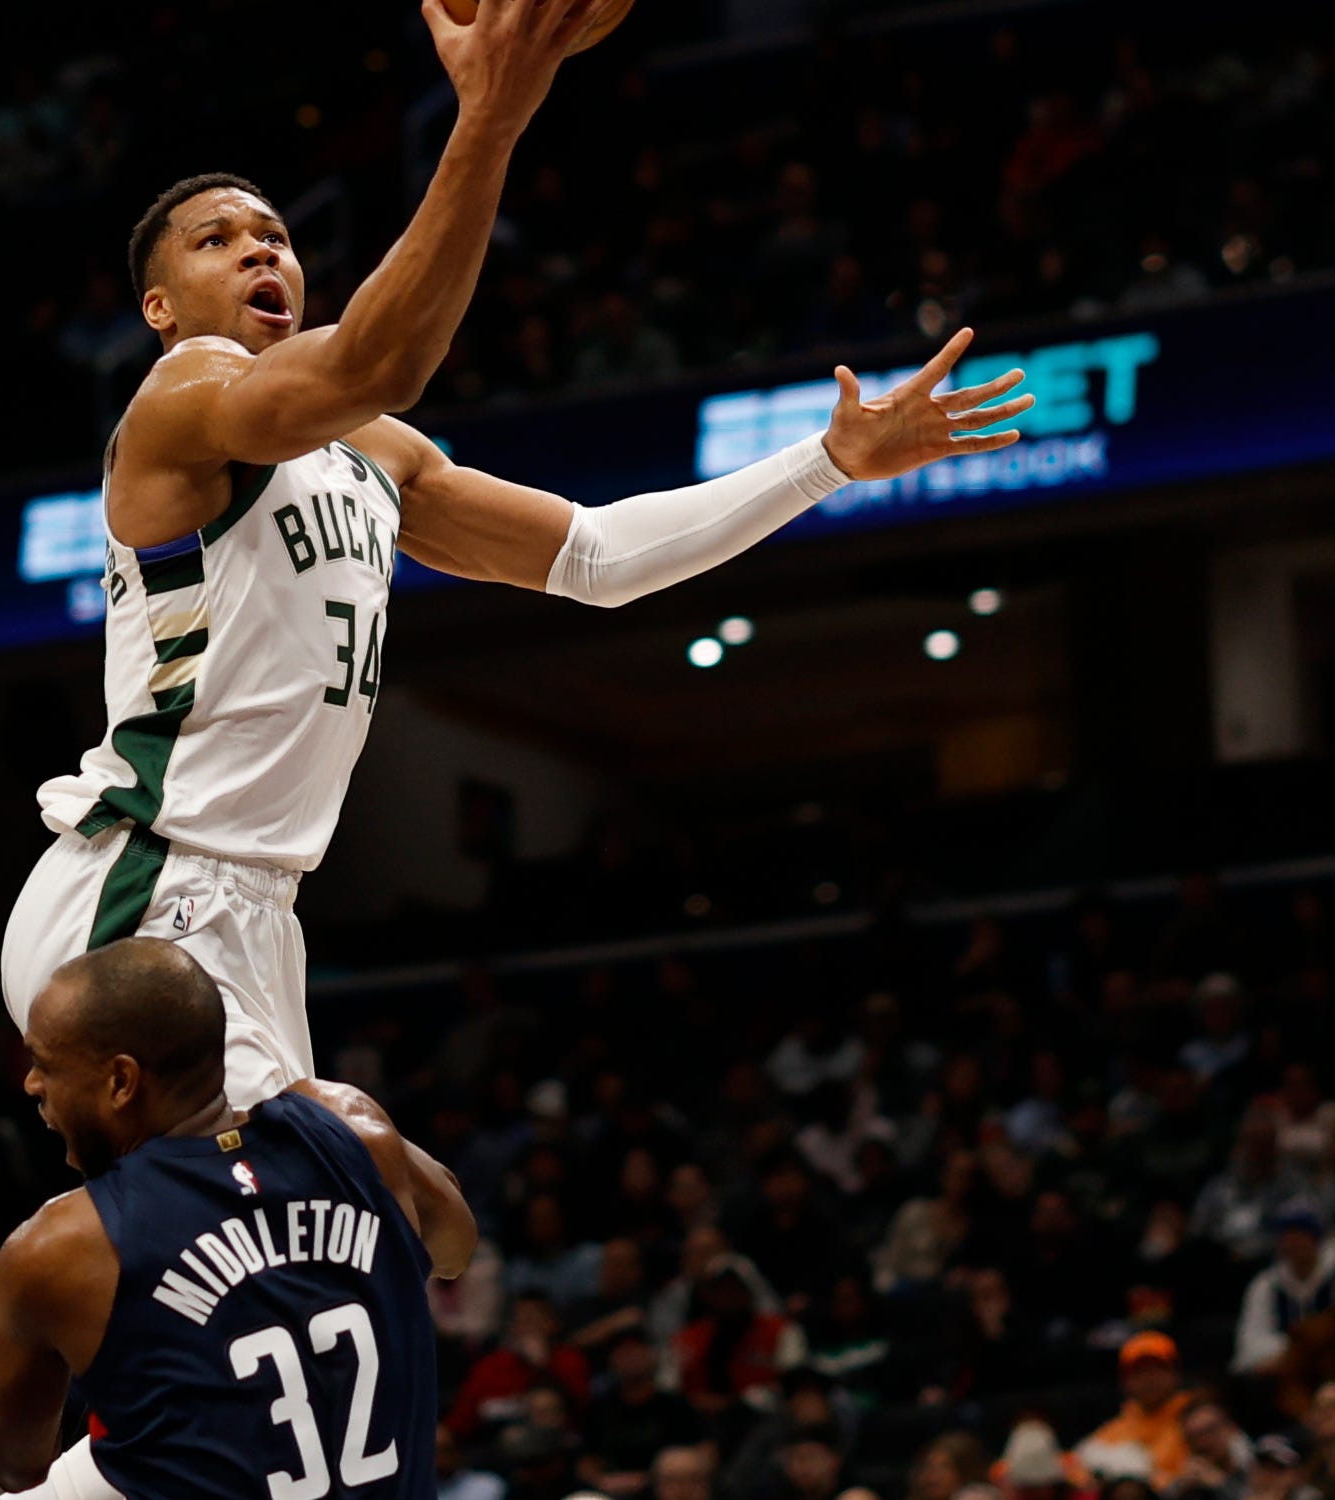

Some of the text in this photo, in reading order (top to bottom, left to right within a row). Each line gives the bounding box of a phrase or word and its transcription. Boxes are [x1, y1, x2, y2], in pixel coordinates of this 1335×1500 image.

[323, 600, 379, 715] 34
[152, 1200, 381, 1326] MIDDLETON
[229, 1303, 399, 1500] 32
